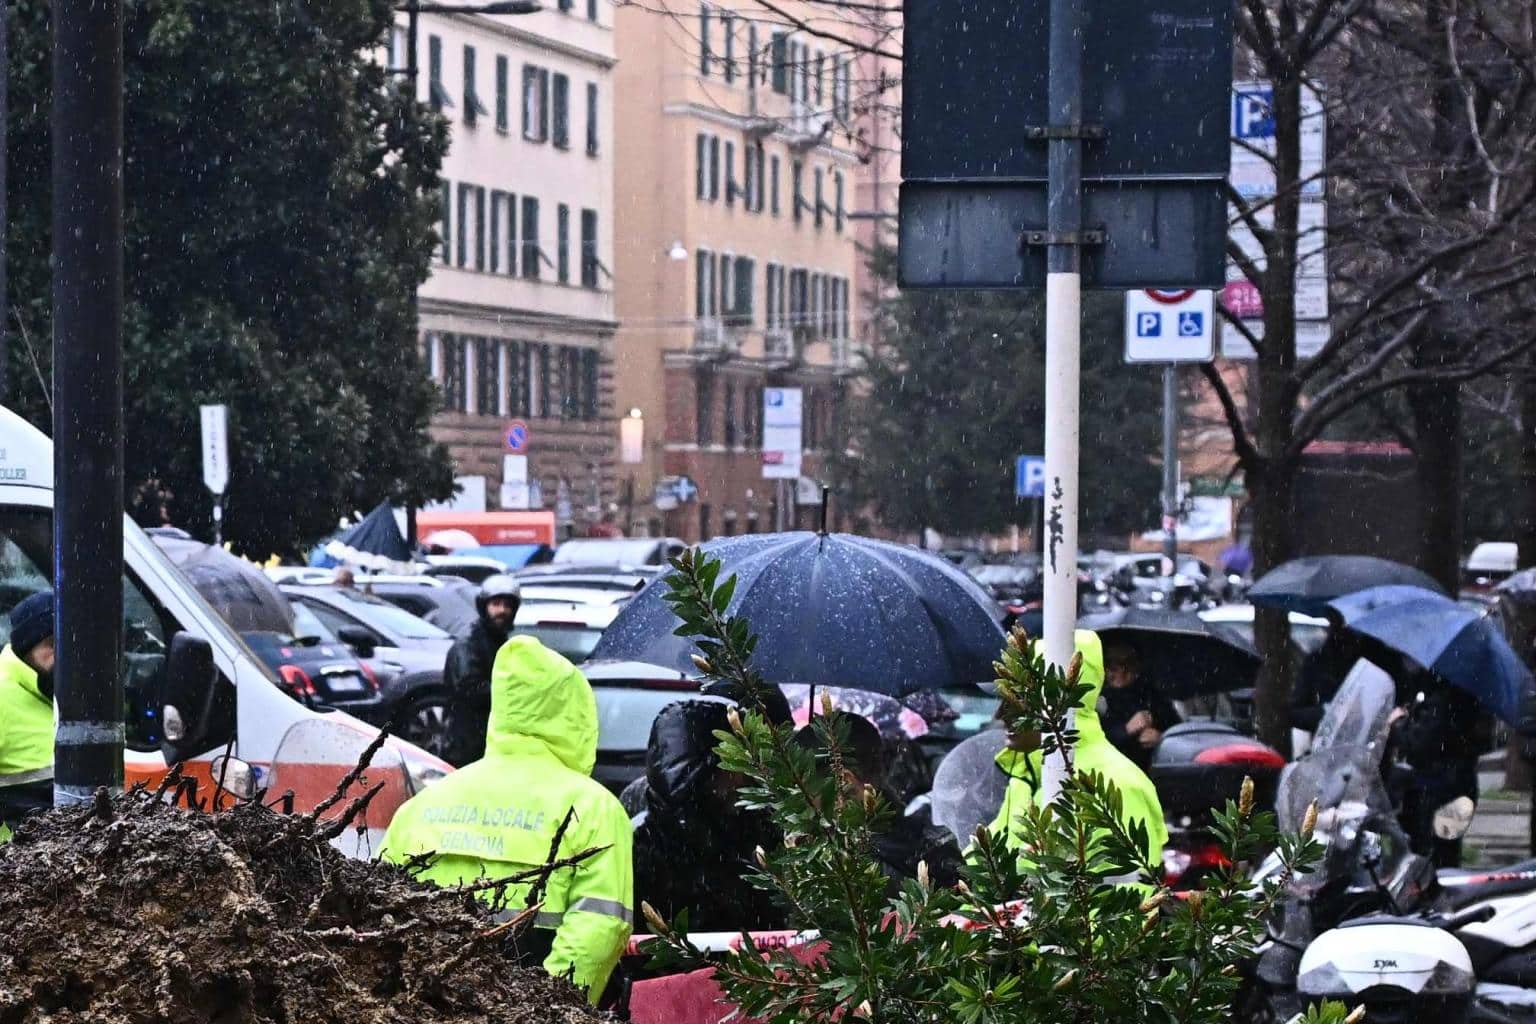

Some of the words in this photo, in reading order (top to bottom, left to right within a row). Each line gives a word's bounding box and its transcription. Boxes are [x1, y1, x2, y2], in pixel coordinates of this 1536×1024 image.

[1140, 315, 1157, 335] P
[481, 806, 545, 831] LOCALE
[440, 830, 504, 856] GENOVA
